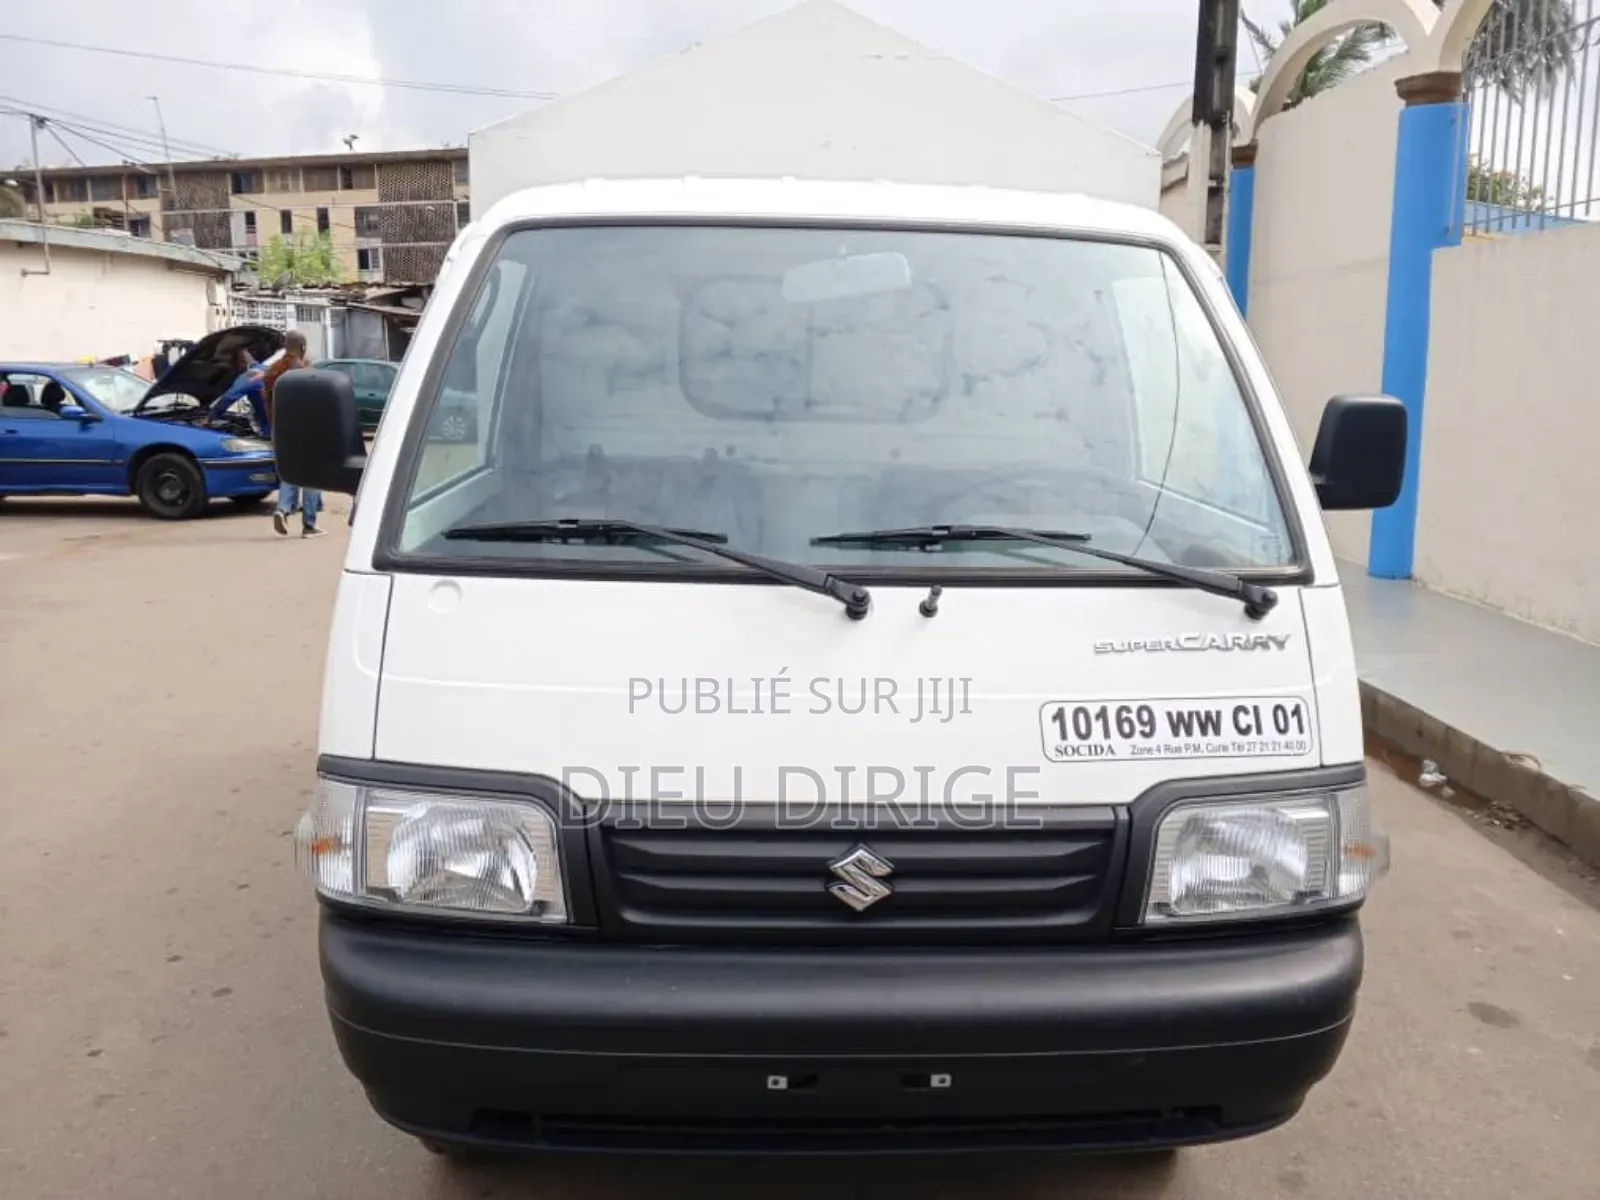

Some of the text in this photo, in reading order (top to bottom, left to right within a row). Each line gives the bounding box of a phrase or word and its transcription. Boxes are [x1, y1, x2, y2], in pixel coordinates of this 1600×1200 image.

[1051, 703, 1304, 742] 10169 WW CI 01
[1054, 743, 1116, 758] SOCIDA
